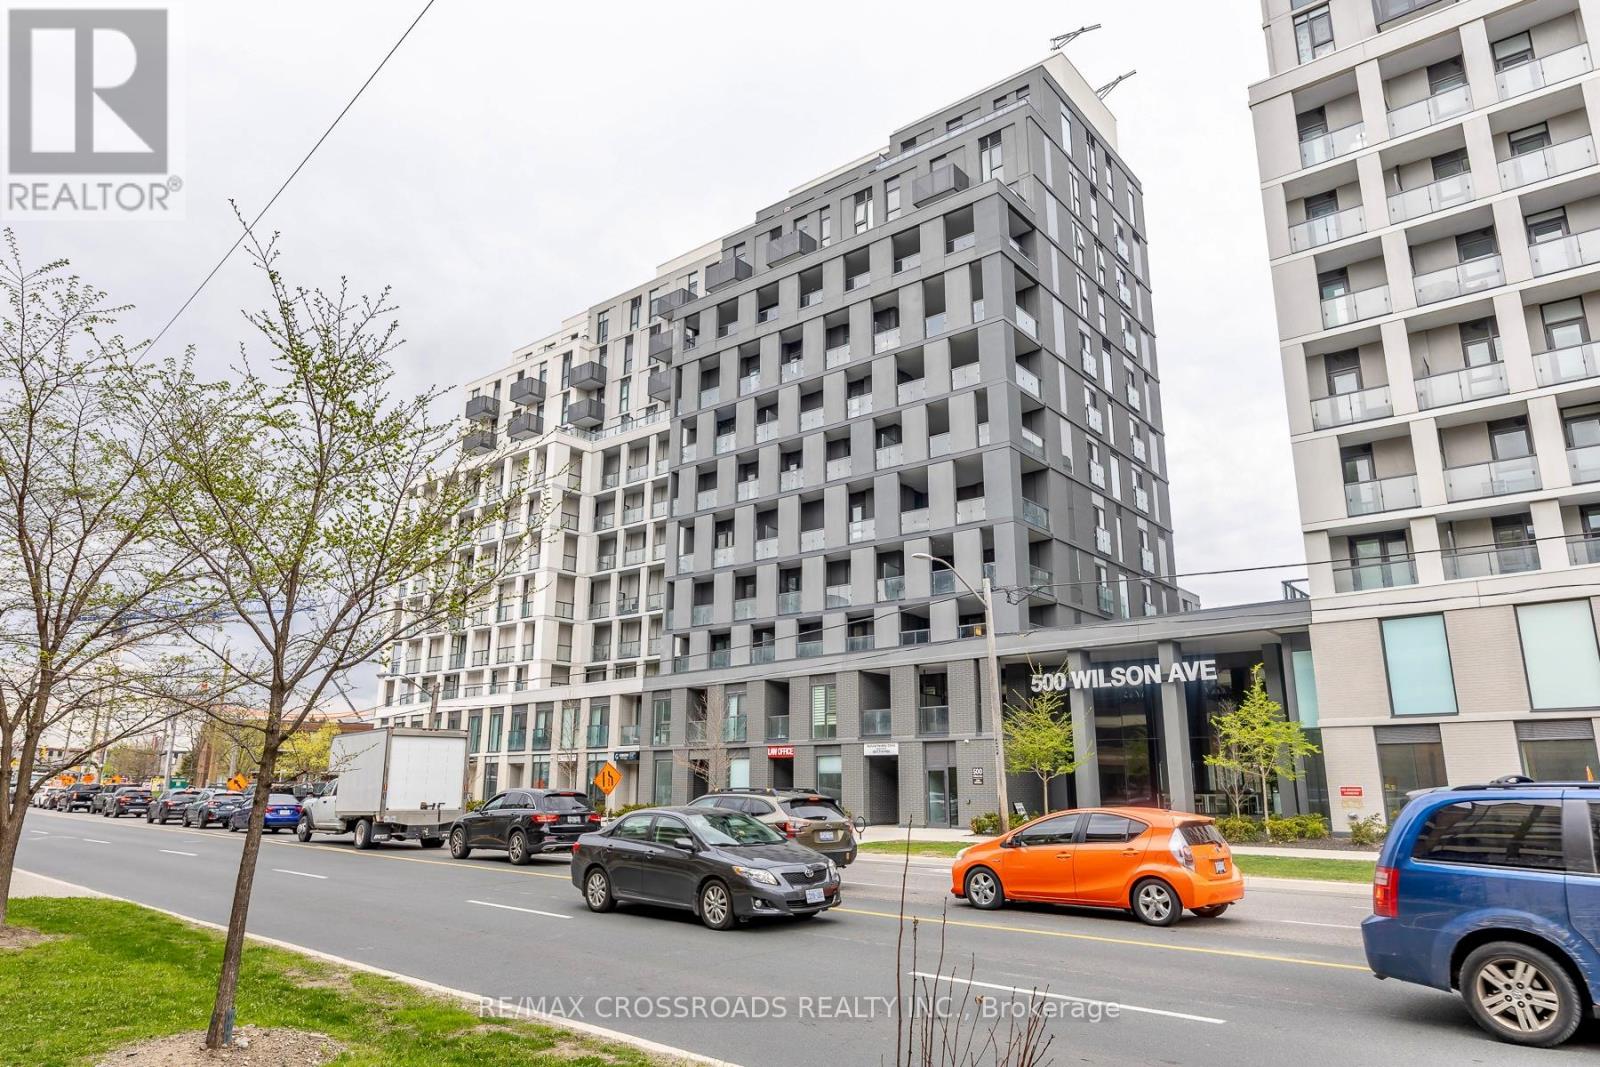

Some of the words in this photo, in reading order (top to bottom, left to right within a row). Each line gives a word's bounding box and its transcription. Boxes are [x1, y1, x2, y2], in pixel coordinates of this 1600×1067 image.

[1031, 673, 1067, 693] 500
[1070, 664, 1162, 690] WILSON
[1168, 659, 1218, 683] AVE
[768, 747, 778, 756] LAW
[778, 747, 794, 756] OFFICE
